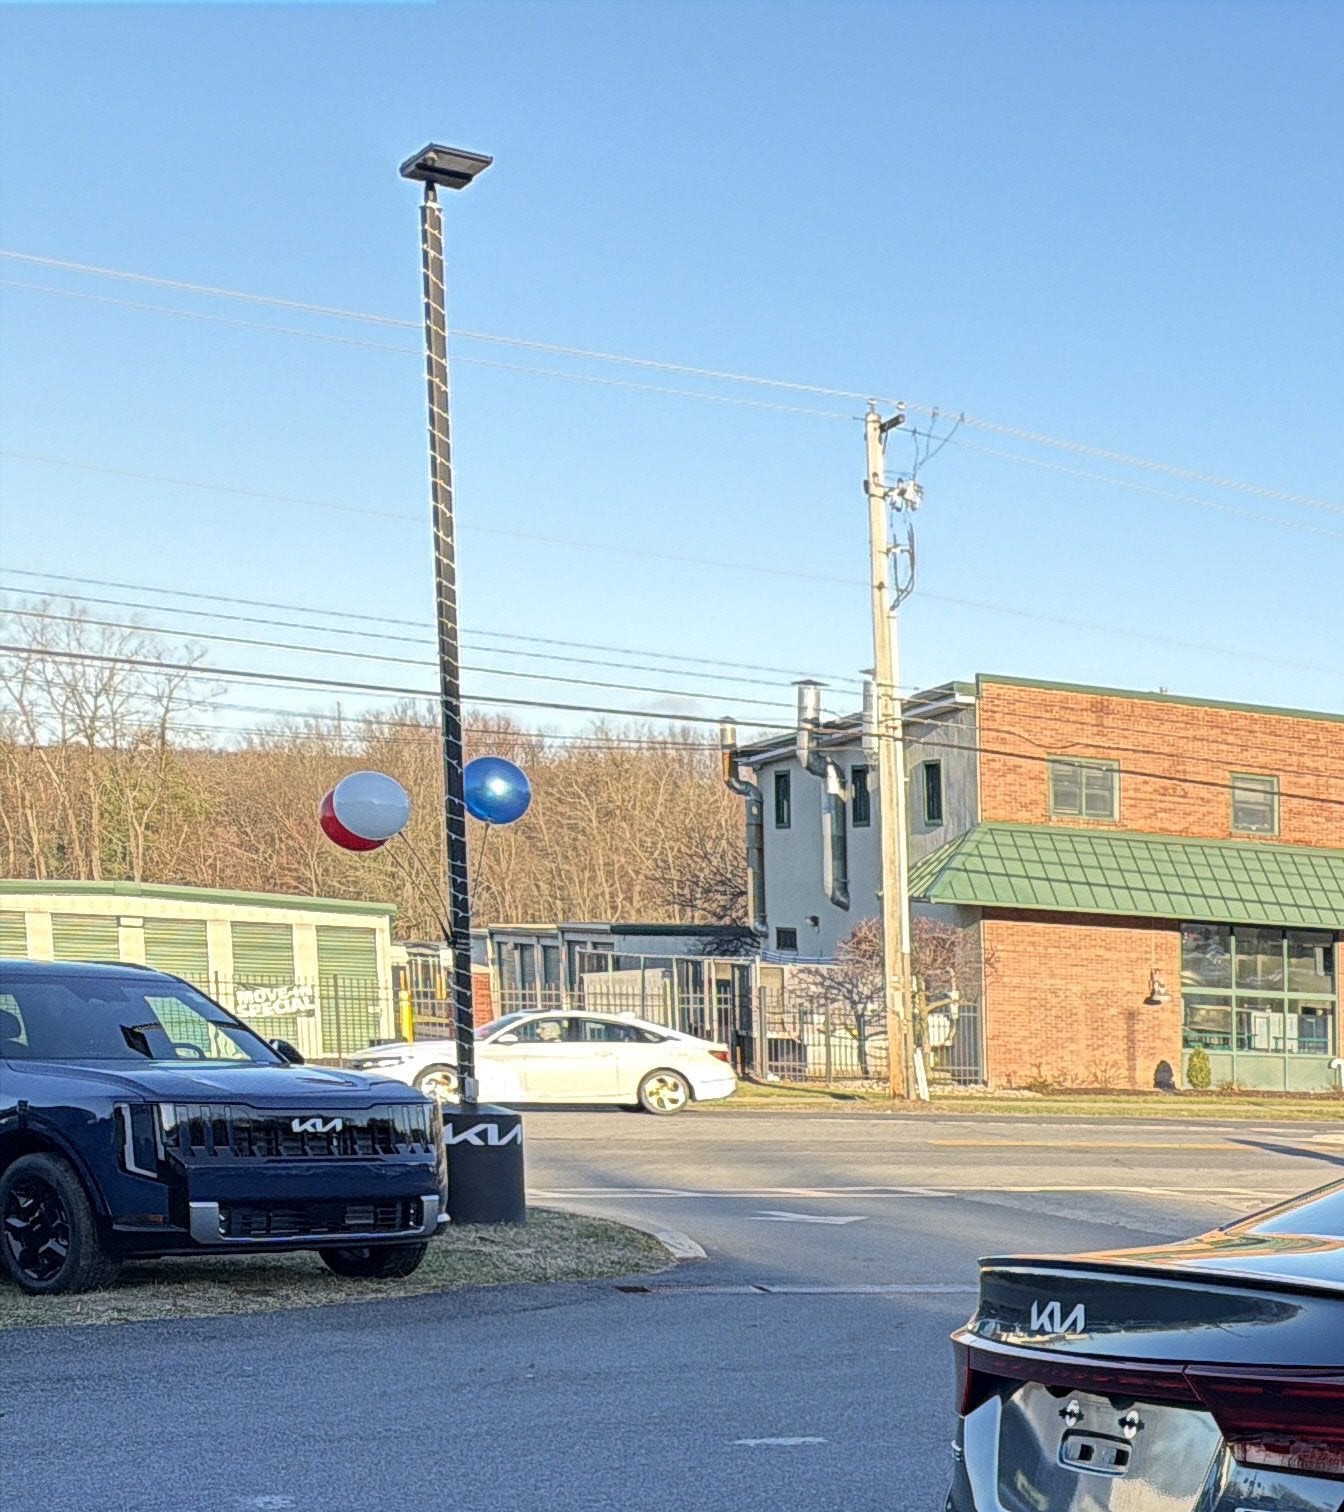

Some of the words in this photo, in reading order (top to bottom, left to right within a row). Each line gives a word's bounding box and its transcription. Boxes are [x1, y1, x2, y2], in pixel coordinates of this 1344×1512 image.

[236, 996, 315, 1016] SPECIAL
[291, 1118, 343, 1133] KIA
[442, 1123, 521, 1146] KIA
[1030, 1299, 1085, 1334] KIA
